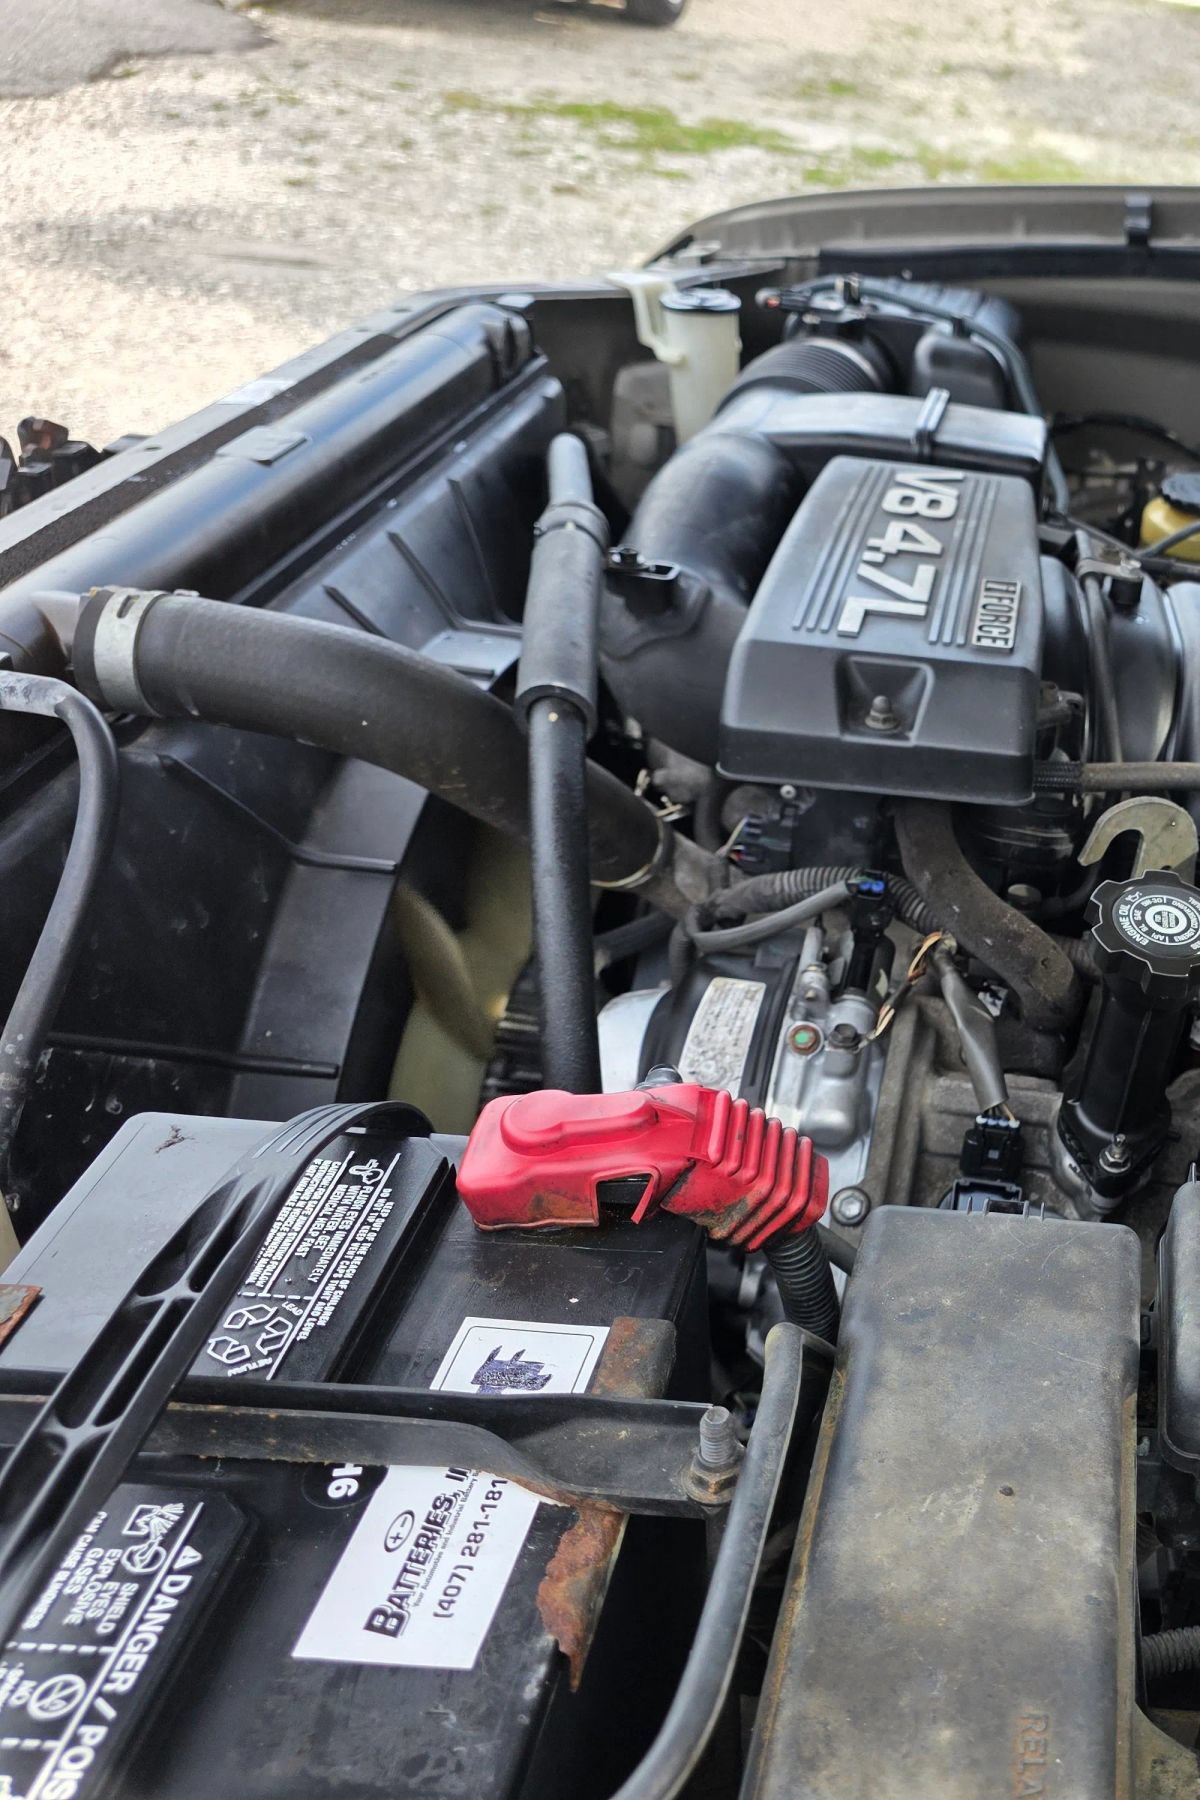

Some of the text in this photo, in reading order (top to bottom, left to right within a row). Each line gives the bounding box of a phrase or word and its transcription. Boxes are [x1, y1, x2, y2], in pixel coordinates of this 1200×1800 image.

[880, 472, 964, 520] V8
[1118, 903, 1150, 946] ENGINE OIL
[339, 1184, 361, 1205] WITH
[370, 1198, 386, 1211] NOT
[379, 1187, 392, 1197] DO
[279, 1207, 303, 1231] VEHICLE
[293, 1183, 348, 1256] MEDICAL HELP FAST
[300, 1201, 318, 1215] SAFE
[306, 1185, 374, 1281] FLUSH EYES IMMEDIATELY
[311, 1235, 330, 1249] GET
[353, 1225, 370, 1241] KEEP
[315, 1201, 395, 1326] KEEP OUT OF THE REACH OF CHILDREN
[342, 1242, 360, 1259] VENT
[254, 1261, 278, 1286] FOLLOW
[331, 1261, 349, 1278] CAPS
[319, 1279, 339, 1299] TIGHT
[281, 1300, 303, 1316] LEAD
[309, 1301, 326, 1317] AND
[445, 1504, 465, 1533] Industrial
[59, 1534, 94, 1569] CAUSE
[441, 1536, 450, 1549] and
[60, 1546, 105, 1597] GASES
[420, 1551, 444, 1588] Automotive
[19, 1569, 71, 1631] BLINDNESS
[60, 1546, 124, 1627] EXPLOSIVE
[82, 1578, 121, 1621] EYES
[413, 1592, 424, 1607] Your
[432, 1563, 474, 1615] (407)
[93, 1580, 140, 1636] SHIELD
[99, 1574, 195, 1693] DANGER
[6, 1679, 38, 1706] NO
